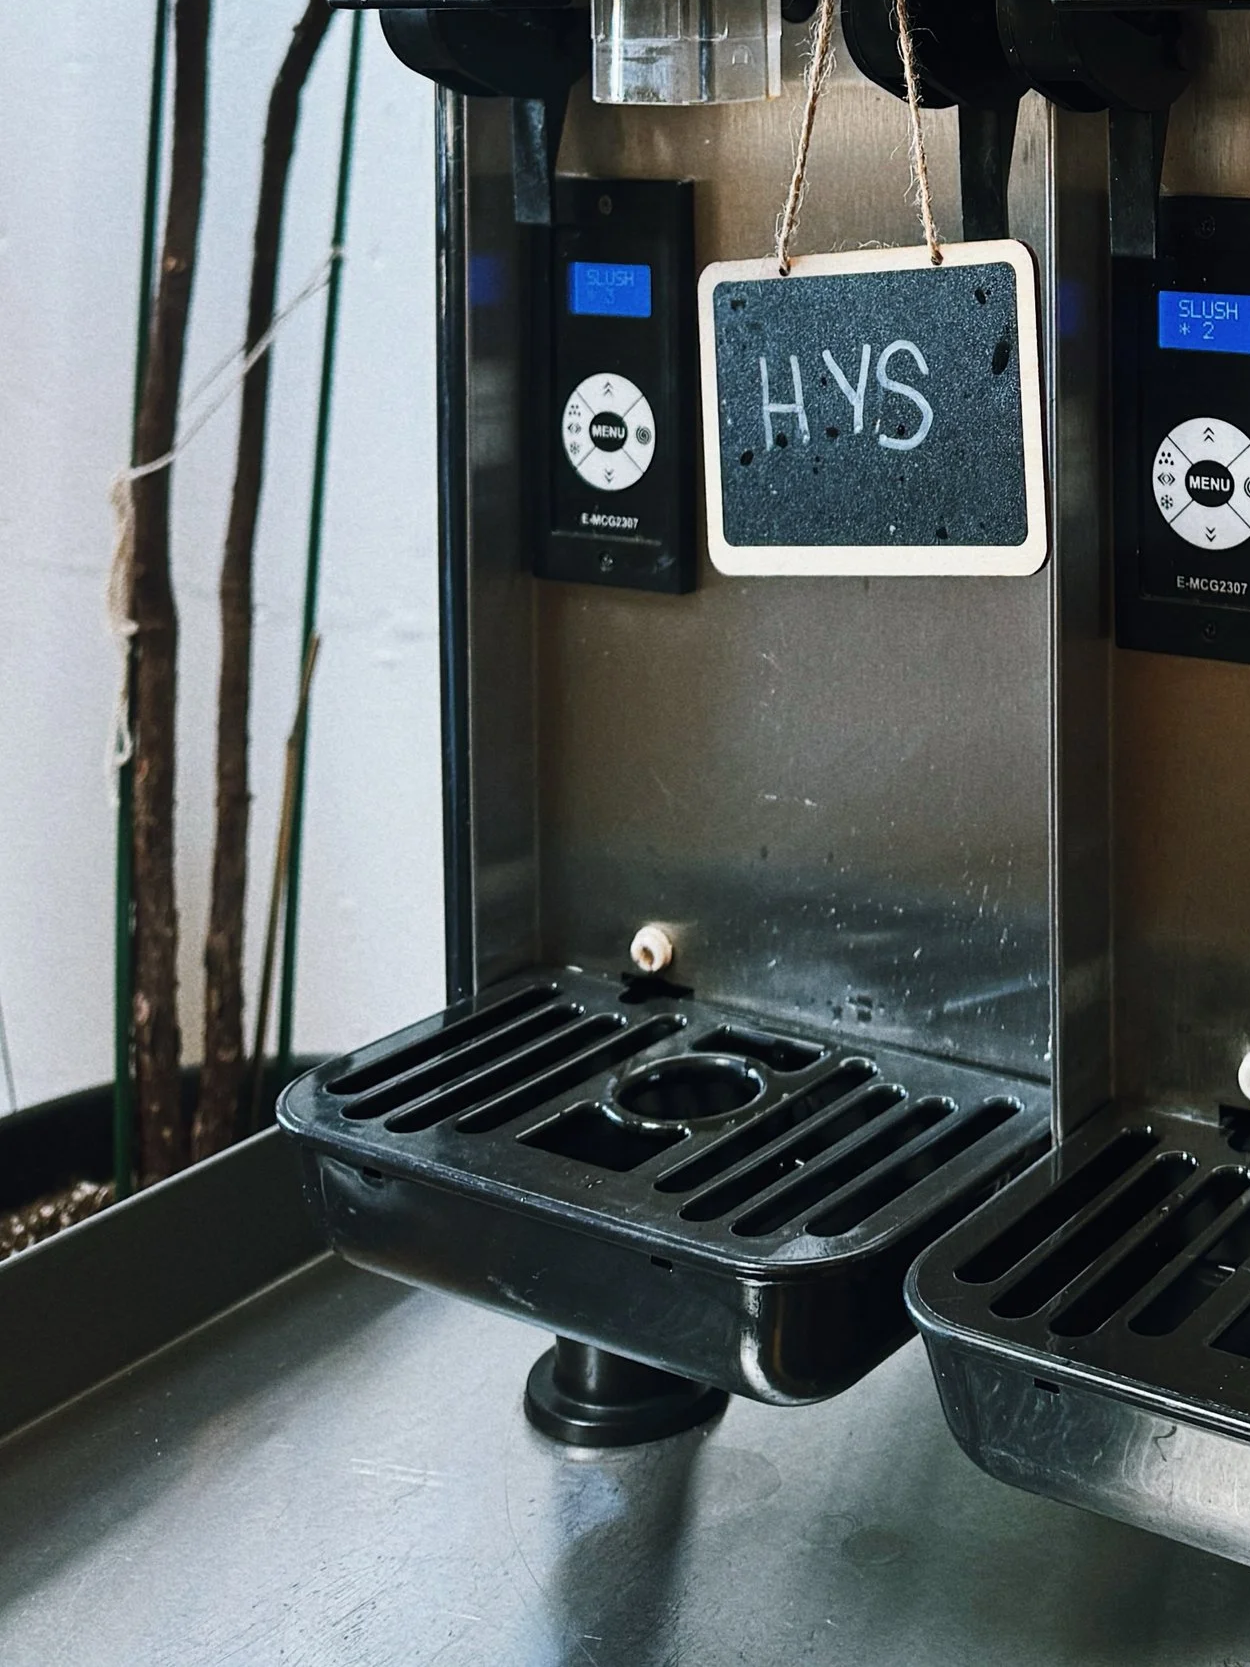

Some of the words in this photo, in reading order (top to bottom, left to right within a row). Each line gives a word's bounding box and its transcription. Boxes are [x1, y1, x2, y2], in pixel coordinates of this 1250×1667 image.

[586, 269, 635, 287] SLUSH
[1178, 299, 1239, 321] SLUSH
[1202, 321, 1215, 340] 2
[758, 339, 934, 451] HYS
[592, 423, 626, 441] MENU
[1188, 475, 1231, 492] MENU
[1176, 576, 1248, 595] E-MCG2307
